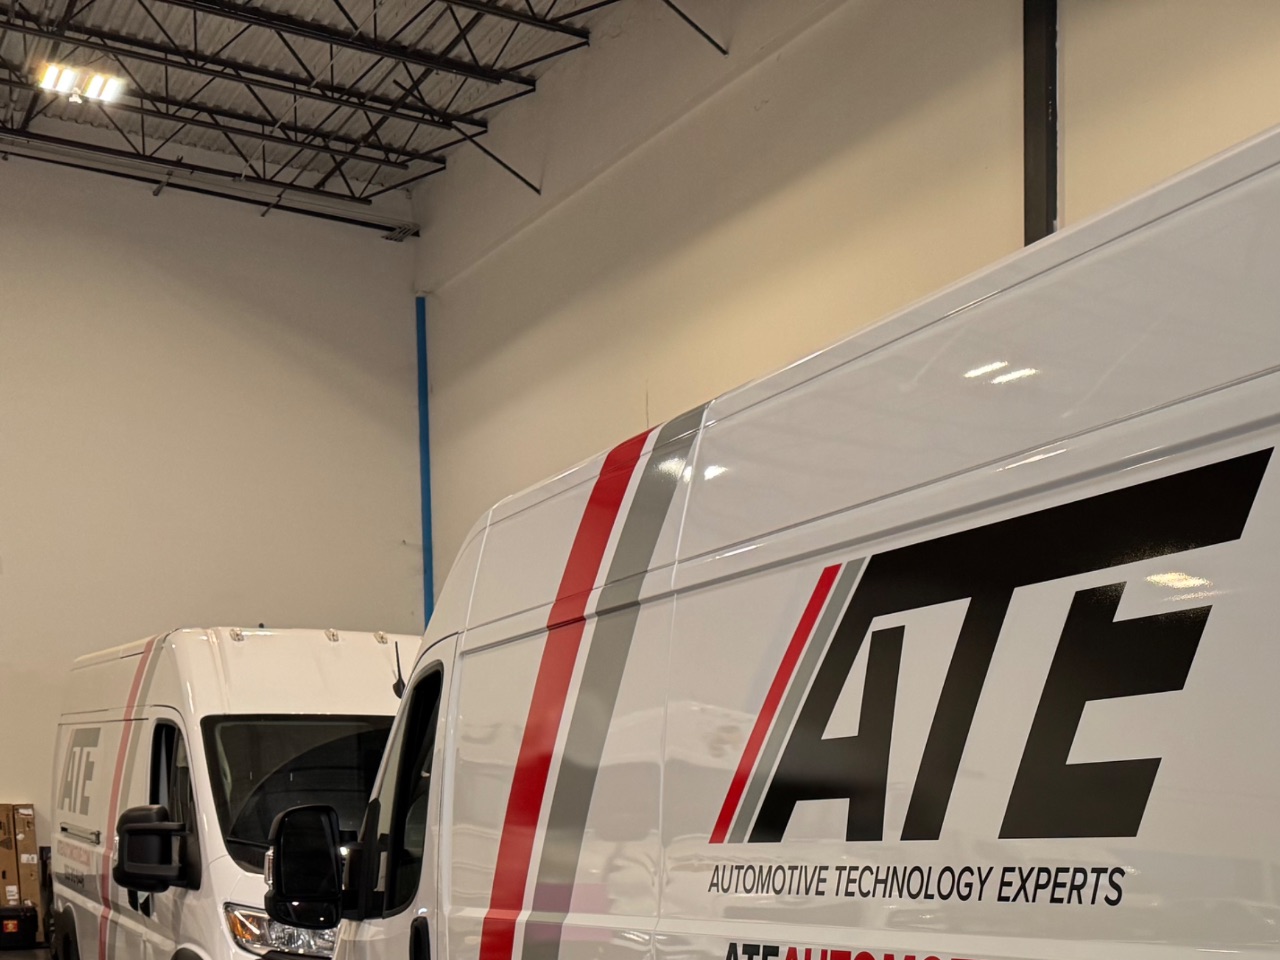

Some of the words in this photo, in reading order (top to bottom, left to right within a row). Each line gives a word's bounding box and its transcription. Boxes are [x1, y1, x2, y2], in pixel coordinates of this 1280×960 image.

[747, 446, 1275, 843] ATE
[708, 864, 828, 896] AUTOMOTIVE
[834, 865, 994, 902] TECHNOLOGY
[997, 866, 1126, 907] EXPERTS
